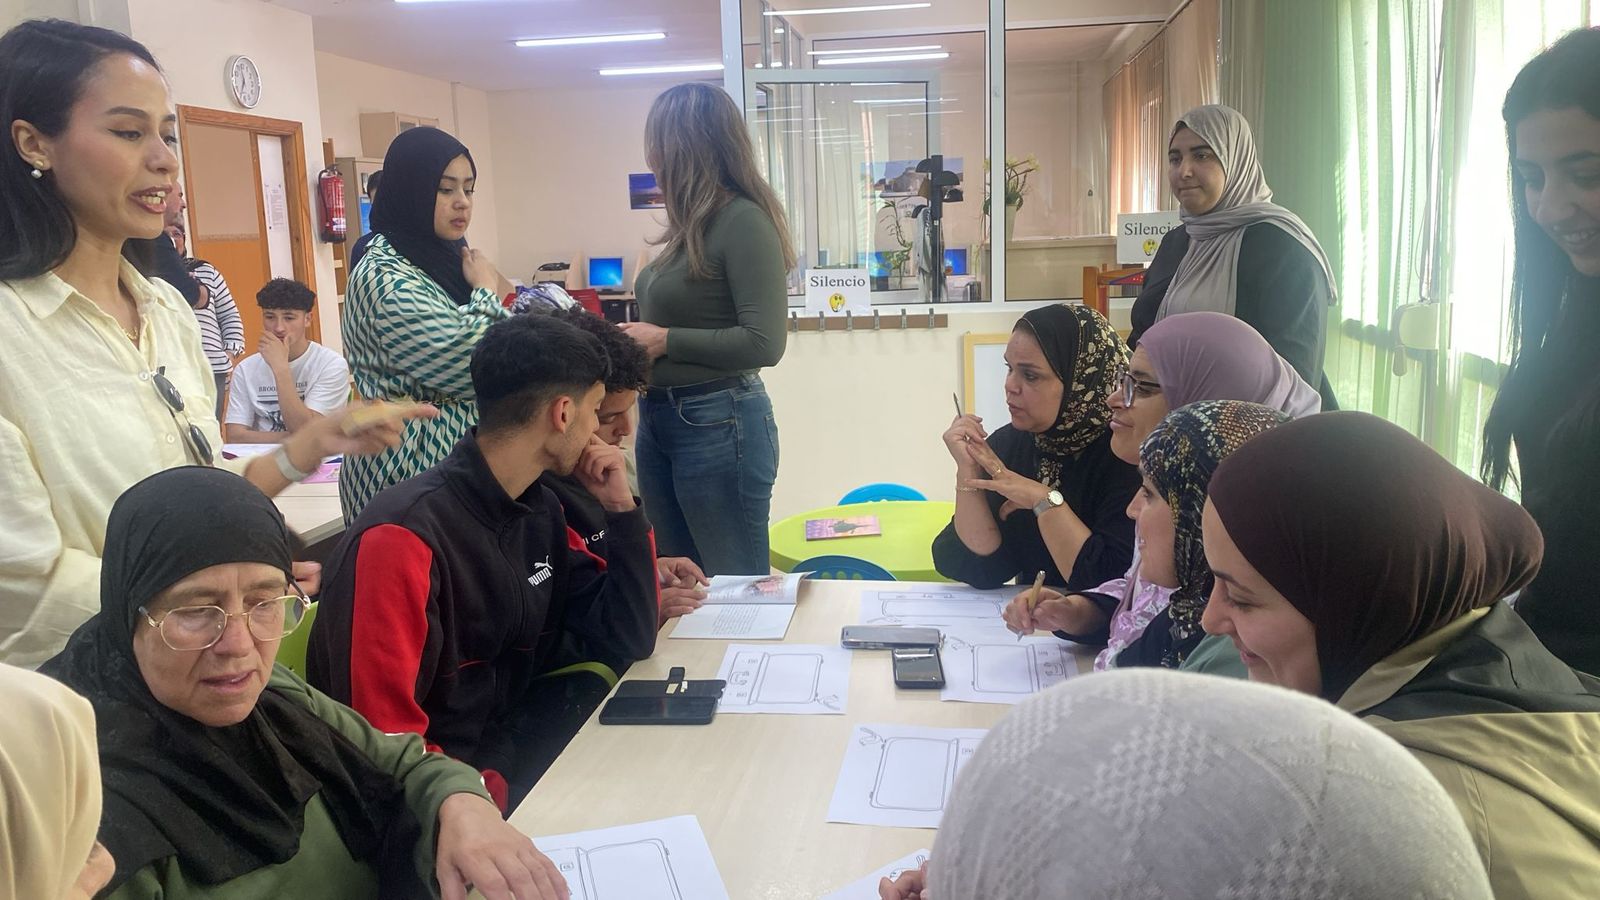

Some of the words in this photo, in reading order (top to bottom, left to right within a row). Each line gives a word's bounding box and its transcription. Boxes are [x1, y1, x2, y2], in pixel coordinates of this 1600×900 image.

[1124, 222, 1177, 235] Silenci
[810, 275, 866, 287] Silencio
[527, 567, 552, 587] PUMA
